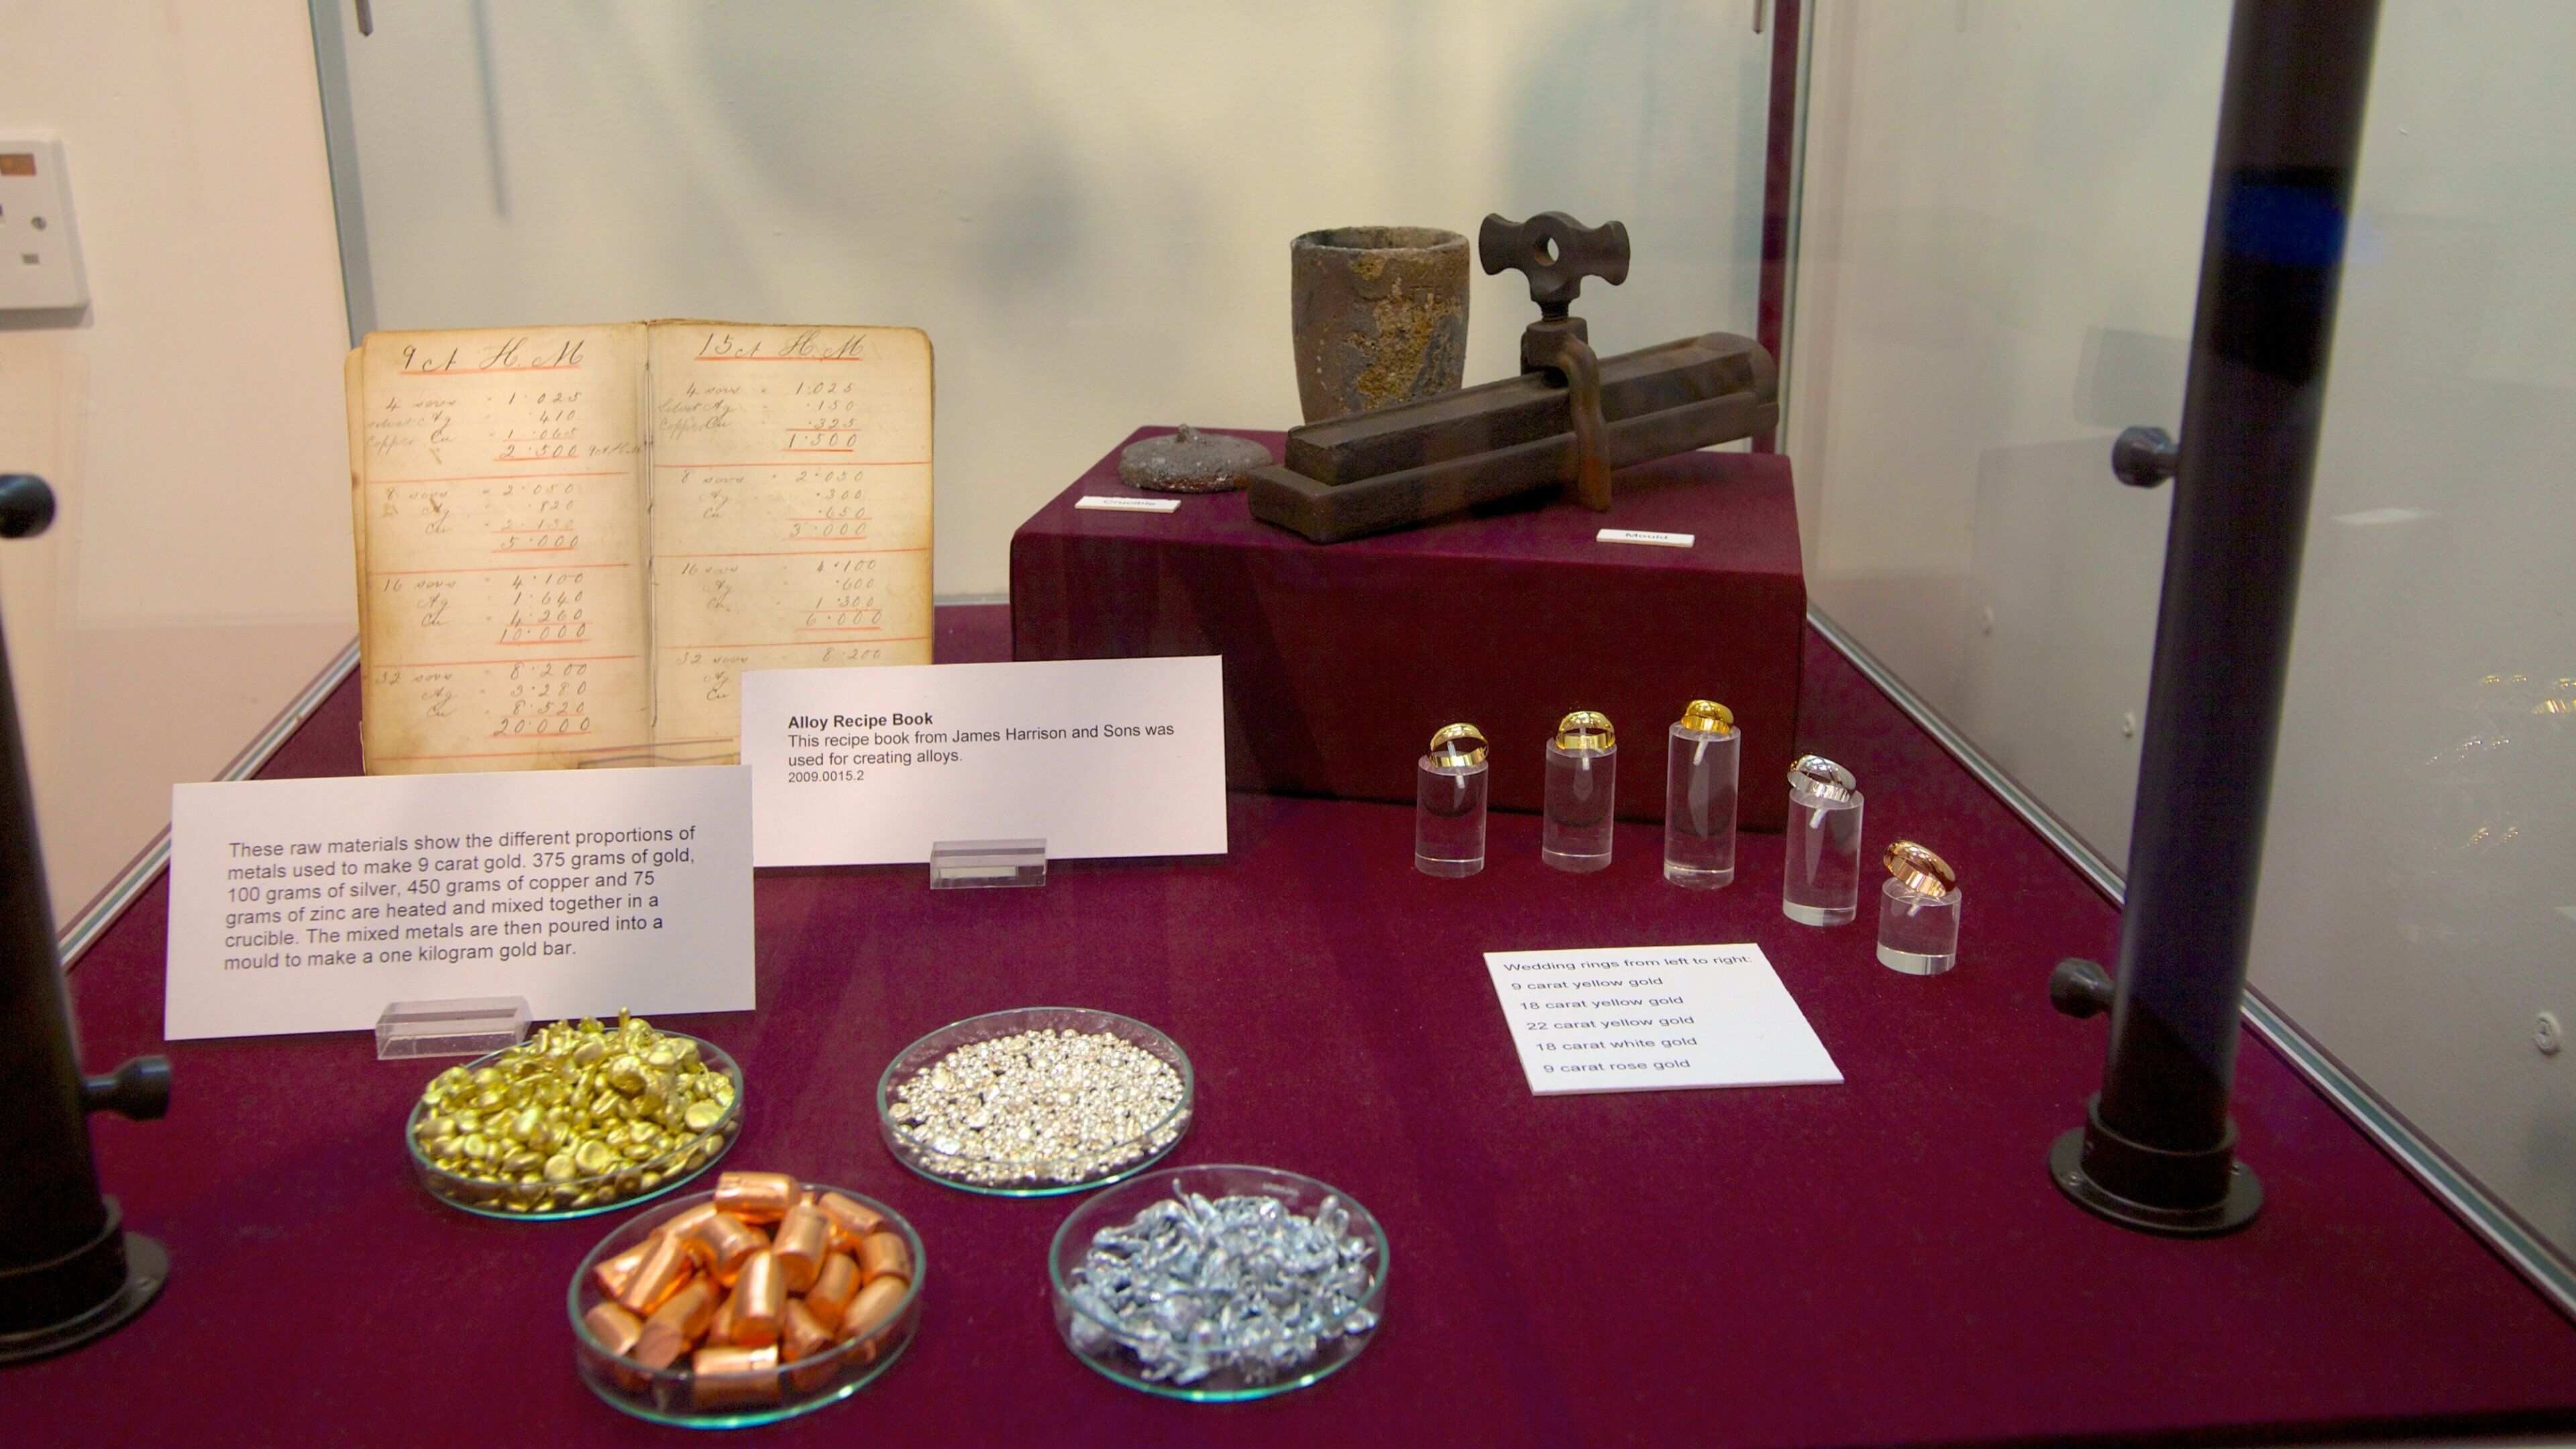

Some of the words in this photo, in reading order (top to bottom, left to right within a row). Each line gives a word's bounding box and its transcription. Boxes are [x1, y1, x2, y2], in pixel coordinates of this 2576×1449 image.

[383, 579, 402, 592] 16
[787, 714, 829, 731] Alloy
[833, 713, 888, 731] Recipe
[892, 711, 934, 727] Book
[787, 733, 820, 748] This
[824, 733, 870, 750] recipe
[873, 731, 910, 746] book
[914, 730, 948, 745] from
[951, 729, 1001, 743] James
[1005, 726, 1067, 741] Harrison
[1071, 724, 1099, 739] and
[1103, 724, 1141, 738] Sons
[1144, 724, 1175, 737] was
[788, 752, 824, 767] used
[828, 751, 849, 766] for
[853, 750, 912, 767] creating
[916, 749, 963, 765] alloys.
[788, 769, 865, 783] 2009.0015.2
[227, 842, 285, 859] These
[288, 842, 323, 856] raw
[327, 835, 409, 855] materials
[413, 834, 462, 851] show
[464, 832, 494, 849] the
[497, 829, 572, 847] different
[574, 826, 674, 849] proportions
[678, 824, 697, 841] of
[226, 863, 288, 881] metals
[292, 860, 337, 878] used
[340, 860, 359, 876] to
[363, 857, 413, 875] make
[417, 857, 430, 873] 9
[433, 855, 480, 873] carat
[482, 853, 527, 874] gold.
[531, 851, 566, 869] 375
[570, 853, 627, 871] grams
[630, 847, 650, 865] of
[651, 846, 695, 867] gold,
[227, 885, 261, 903] 100
[264, 887, 323, 906] grams
[326, 881, 347, 899] of
[348, 881, 401, 899] silver,
[406, 878, 441, 896] 450
[445, 879, 502, 898] grams
[505, 874, 526, 892] of
[527, 875, 592, 896] copper
[594, 870, 629, 888] and
[632, 869, 655, 886] 75
[225, 911, 282, 929] grams
[287, 906, 307, 922] of
[309, 905, 346, 922] zinc
[351, 907, 380, 920] are
[386, 900, 447, 918] heated
[452, 898, 486, 916] and
[491, 896, 544, 914] mixed
[549, 894, 623, 915] together
[627, 893, 643, 908] in
[648, 896, 659, 908] a
[224, 929, 300, 949] crucible.
[305, 927, 341, 945] The
[345, 924, 400, 943] mixed
[404, 922, 465, 940] metals
[468, 924, 499, 937] are
[502, 919, 543, 936] then
[547, 915, 610, 938] poured
[615, 913, 648, 931] into
[652, 917, 663, 930] a
[223, 952, 280, 971] mould
[284, 952, 303, 968] to
[307, 949, 358, 967] make
[361, 951, 374, 965] a
[378, 950, 414, 963] one
[417, 945, 494, 965] kilogram
[498, 940, 537, 963] gold
[542, 940, 576, 957] bar.
[1503, 962, 1576, 972] Wedding
[1580, 961, 1620, 970] rings
[1623, 959, 1661, 967] from
[1663, 957, 1688, 966] left
[1691, 957, 1709, 965] to
[1511, 982, 1522, 991] 9
[1527, 980, 1570, 990] carat
[1571, 979, 1623, 990] yellow
[1627, 977, 1664, 988] gold
[1519, 1001, 1540, 1011] 18
[1545, 1000, 1589, 1010] carat
[1591, 998, 1644, 1010] yellow
[1647, 996, 1684, 1008] gold
[1526, 1022, 1549, 1031] 22
[1553, 1020, 1597, 1030] carat
[1599, 1018, 1653, 1030] yellow
[1658, 1016, 1695, 1028] gold
[1536, 1042, 1557, 1052] 18
[1562, 1040, 1607, 1051] carat
[1609, 1038, 1656, 1049] white
[1660, 1036, 1698, 1049] gold
[1542, 1064, 1555, 1074] 9
[1560, 1062, 1606, 1073] carat
[1609, 1062, 1648, 1071] rose
[1652, 1059, 1691, 1071] gold
